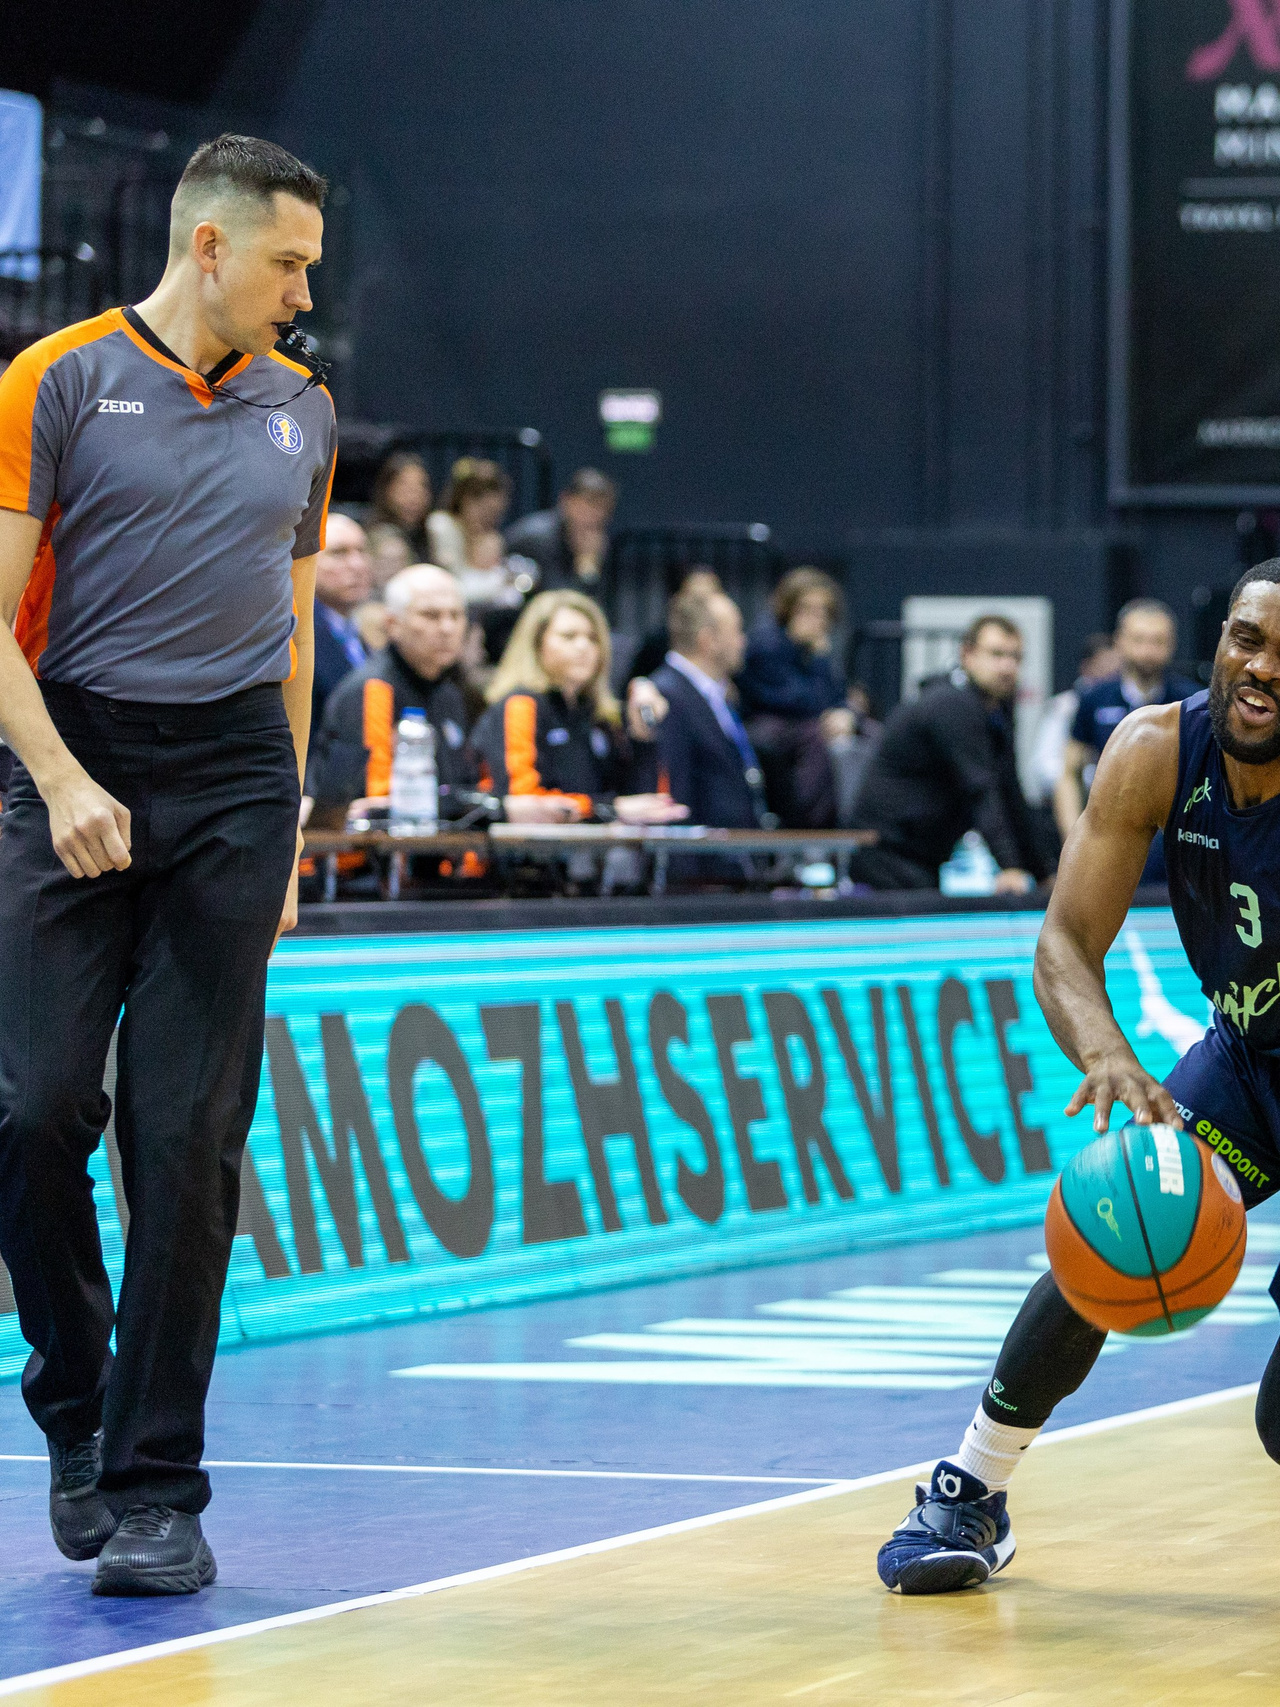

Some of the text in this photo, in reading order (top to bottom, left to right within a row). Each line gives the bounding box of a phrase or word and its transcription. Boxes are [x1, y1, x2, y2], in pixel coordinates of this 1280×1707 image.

[98, 399, 144, 414] ZEDO
[1229, 882, 1263, 949] 3
[1195, 1119, 1270, 1189] евроопт
